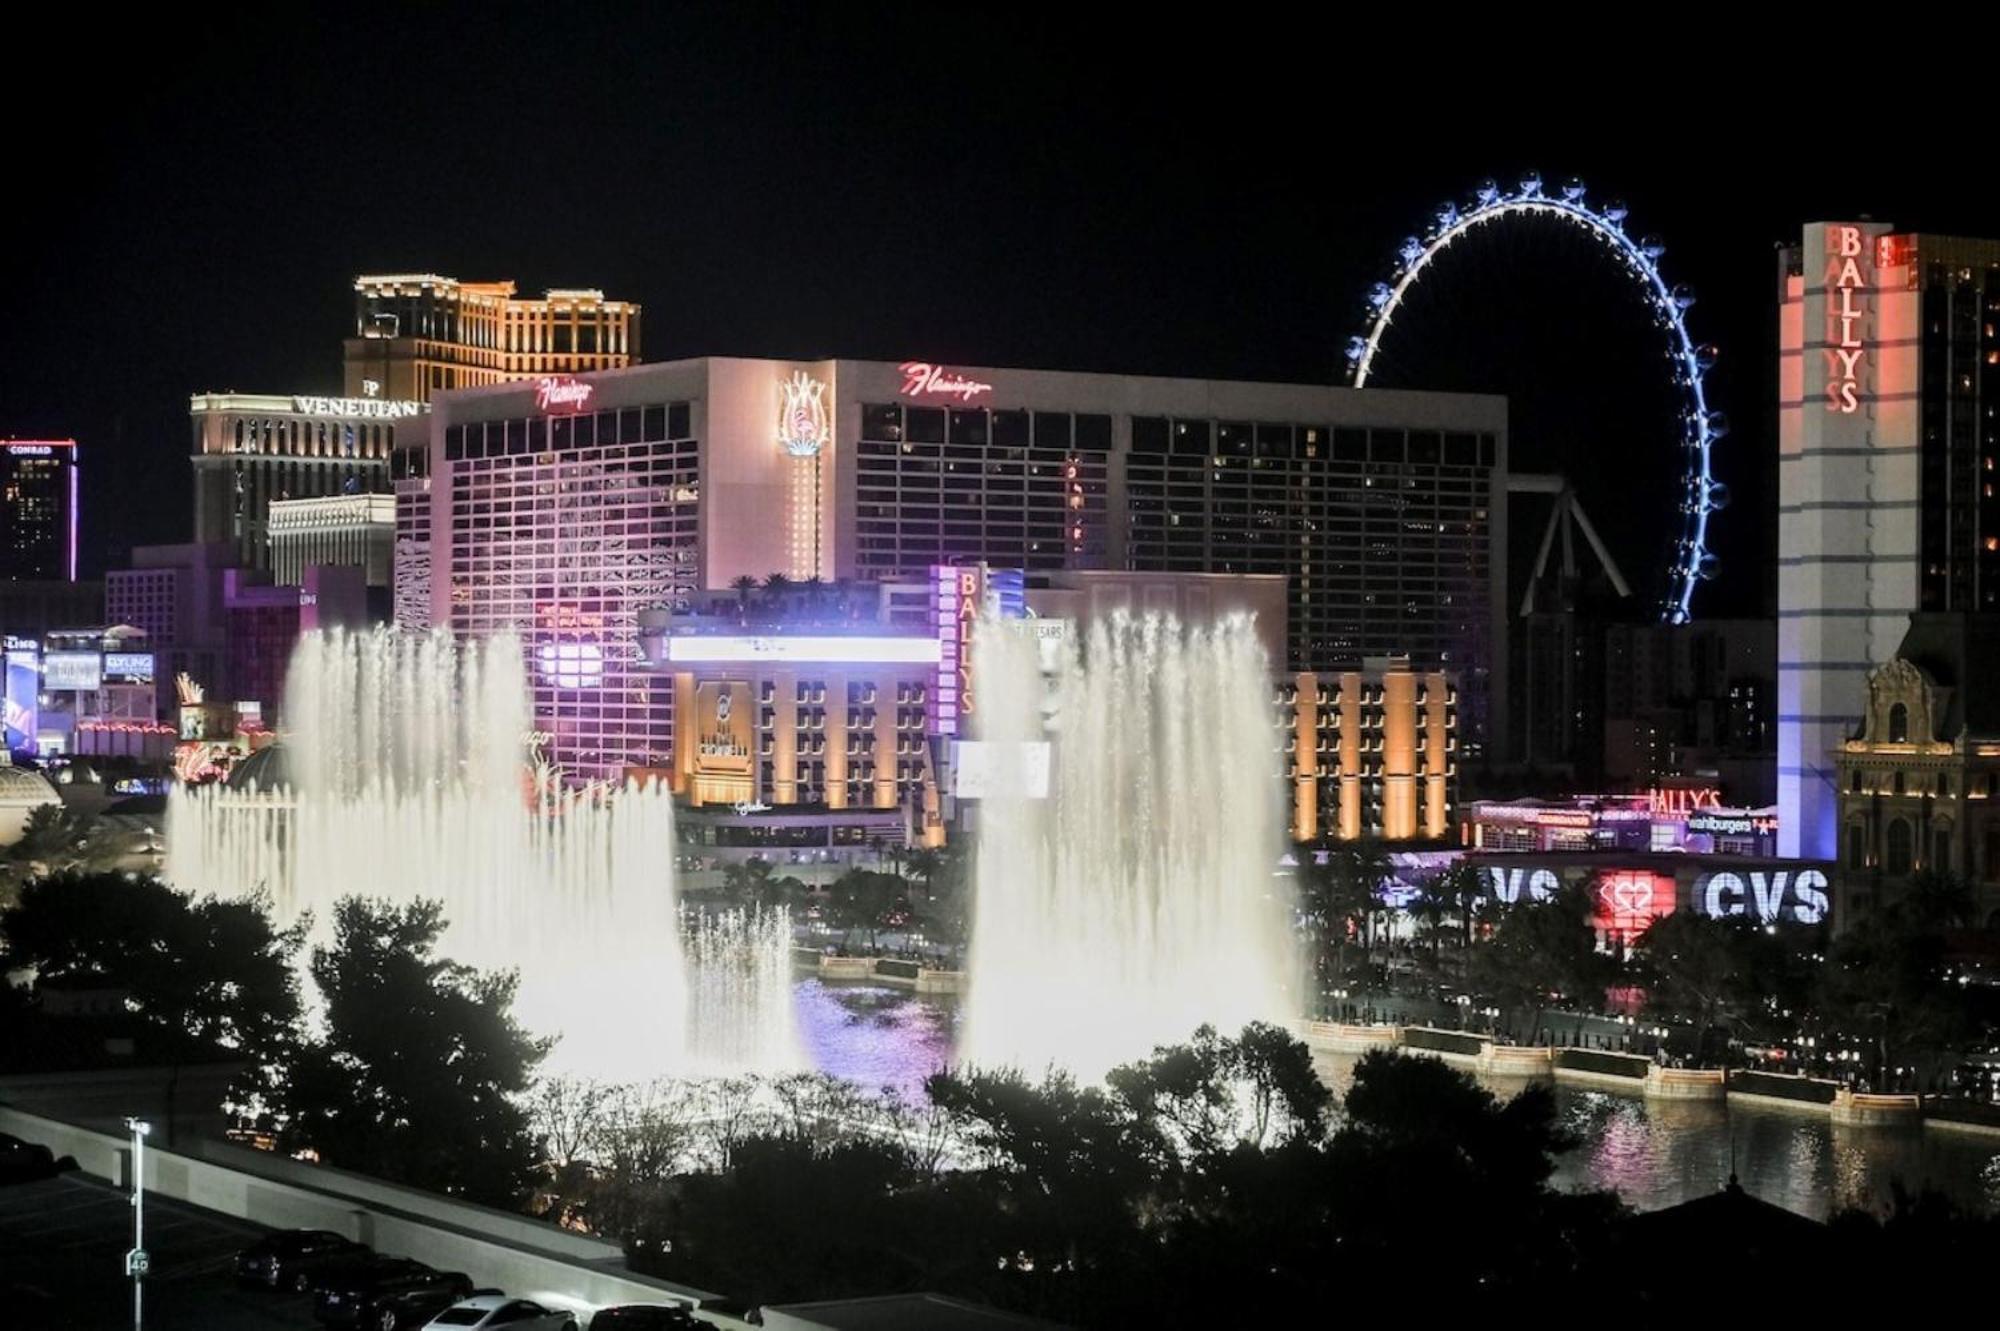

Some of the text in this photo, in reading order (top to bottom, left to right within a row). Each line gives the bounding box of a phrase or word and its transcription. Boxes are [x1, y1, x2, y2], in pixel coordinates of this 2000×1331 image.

[1837, 226, 1863, 414] BALLYS
[541, 377, 593, 410] Flamingo
[906, 363, 992, 400] Flamingo
[295, 397, 419, 417] VENETIAN
[11, 446, 52, 455] CONRAD
[959, 573, 977, 714] BALLYS
[1650, 789, 1720, 815] BALLY'S
[1689, 817, 1751, 834] wahlburgers
[1705, 870, 1829, 924] CVS
